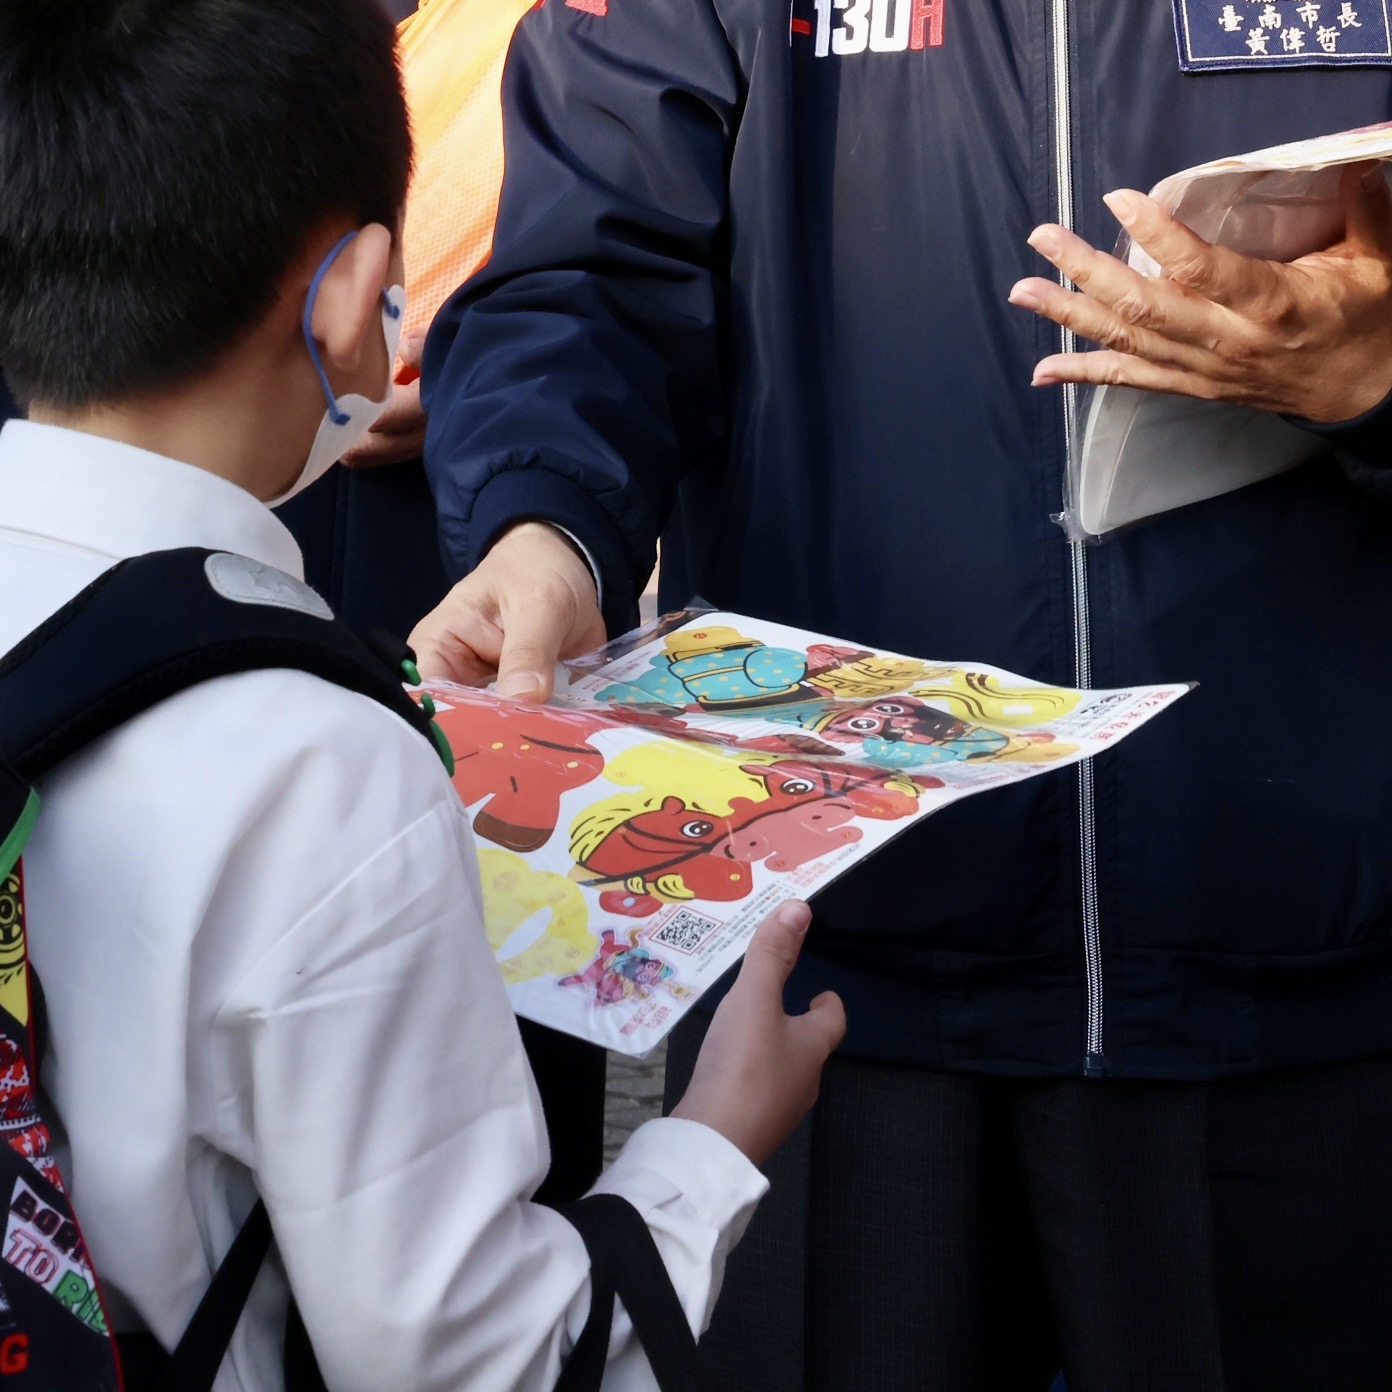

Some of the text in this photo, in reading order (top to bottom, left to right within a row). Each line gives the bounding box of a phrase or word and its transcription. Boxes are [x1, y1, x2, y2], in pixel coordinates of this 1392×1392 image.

[1218, 2, 1362, 31] 臺南市長
[1245, 25, 1341, 55] 黃偉哲
[10, 1189, 86, 1264] BOR
[7, 1228, 60, 1284] TO
